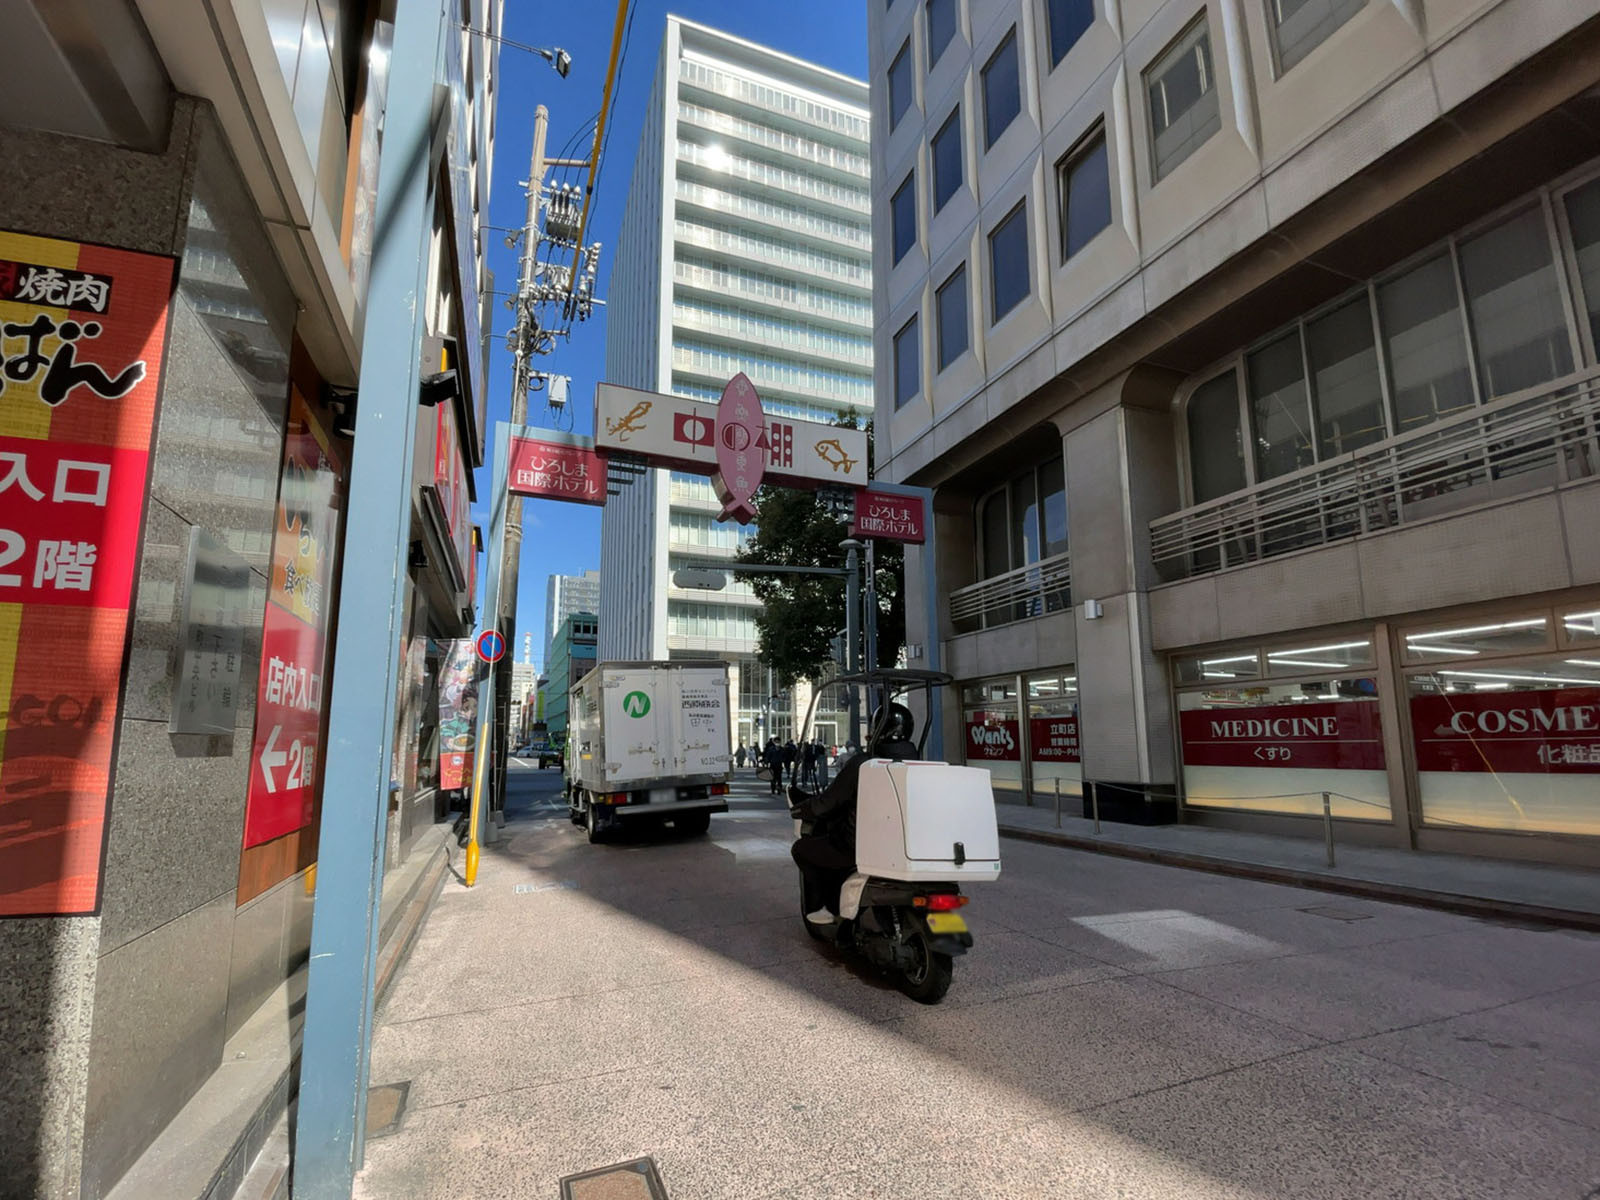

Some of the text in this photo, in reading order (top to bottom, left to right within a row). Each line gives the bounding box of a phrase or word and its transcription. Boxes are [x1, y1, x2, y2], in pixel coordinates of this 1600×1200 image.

[15, 267, 110, 312] 焼肉
[530, 455, 589, 477] ひろしま
[517, 469, 599, 494] 国際ホテル
[869, 504, 911, 521] ひろしま
[860, 516, 919, 535] 国際ホテル
[265, 656, 321, 714] 店内入口
[1210, 716, 1340, 738] MEDICINE
[1450, 705, 1600, 735] COSME
[971, 725, 1014, 751] Wants
[286, 739, 314, 790] 2階
[1253, 746, 1292, 761] くすり
